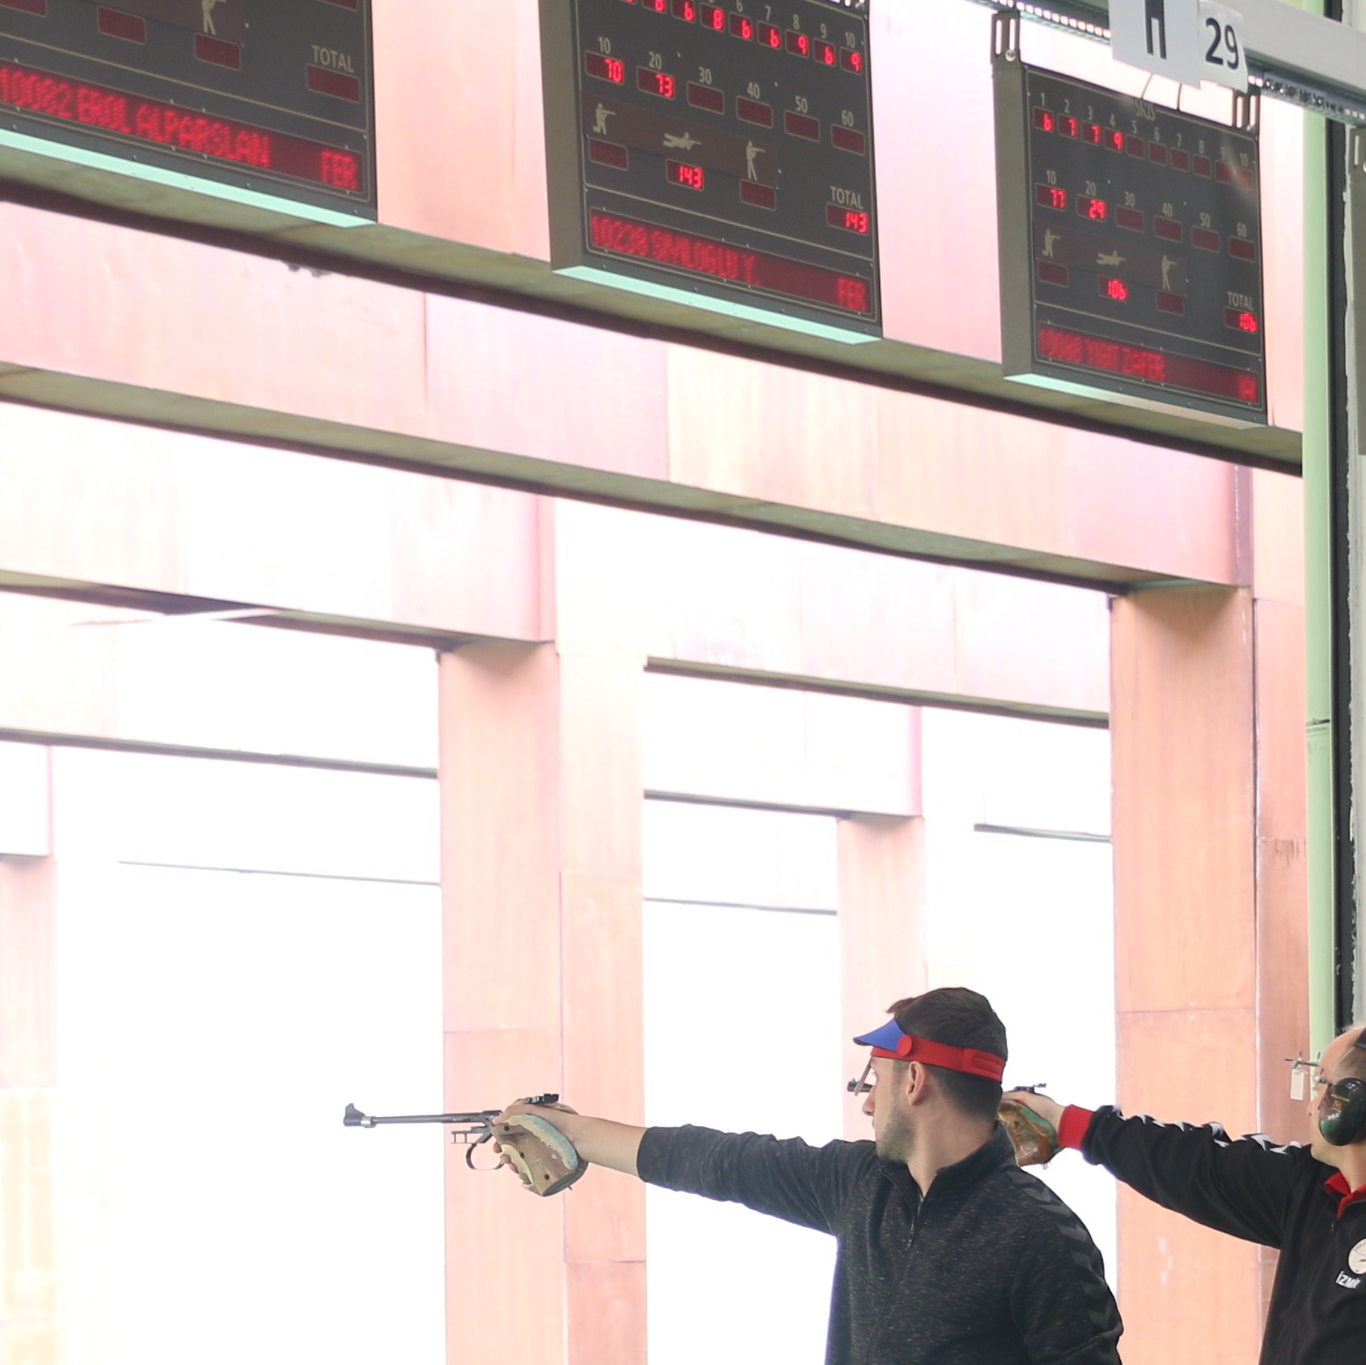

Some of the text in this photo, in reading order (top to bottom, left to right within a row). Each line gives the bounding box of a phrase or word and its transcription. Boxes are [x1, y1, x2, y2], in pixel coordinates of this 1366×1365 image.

[713, 9, 724, 30] 8
[798, 35, 809, 54] 9
[851, 52, 861, 72] 9
[765, 5, 771, 20] 7
[793, 14, 800, 30] 8
[820, 24, 827, 38] 9
[845, 32, 855, 48] 10
[1205, 17, 1239, 70] 29
[311, 44, 355, 72] TOTAL
[599, 37, 853, 126] 10 20 30 40 50 60
[604, 58, 673, 98] 70 73
[1041, 92, 1248, 167] 1 2 3 4 5 6 7 8 9 10
[1068, 118, 1076, 136] 7
[1092, 125, 1099, 143] 7
[1114, 132, 1123, 150] 9
[679, 165, 702, 188] 143
[830, 186, 863, 210] TOTAL
[1046, 169, 1247, 237] 10 20 30 40 50 60
[1050, 188, 1106, 218] 77 29
[845, 211, 868, 234] 143
[1227, 291, 1254, 311] TOTAL
